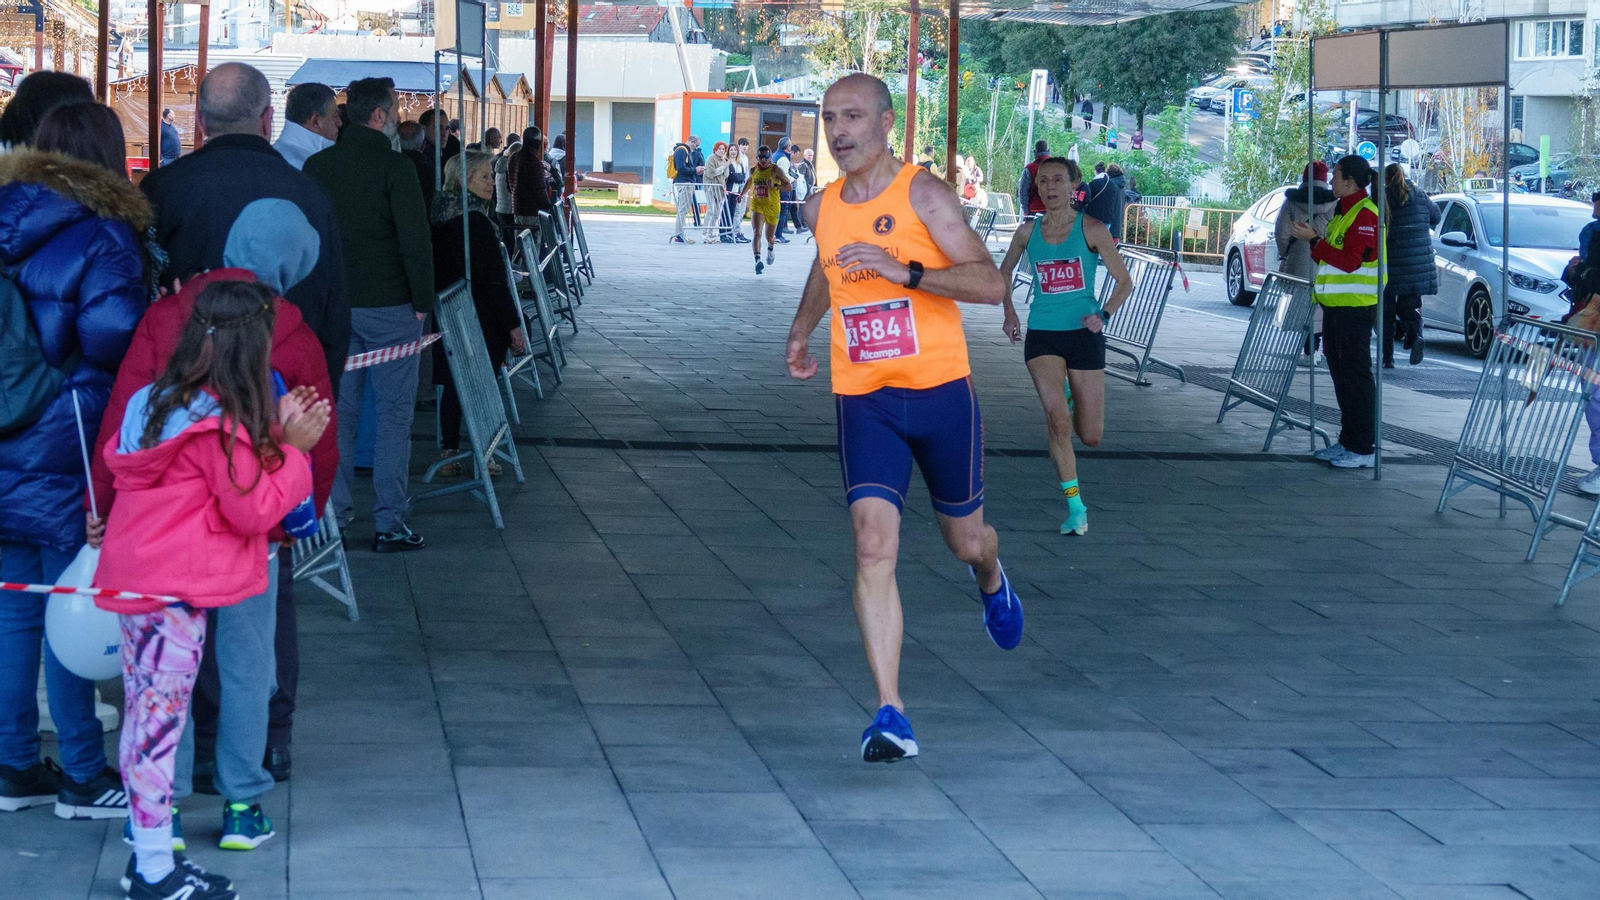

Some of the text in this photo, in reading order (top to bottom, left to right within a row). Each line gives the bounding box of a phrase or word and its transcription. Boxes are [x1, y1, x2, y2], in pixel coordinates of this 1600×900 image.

[1471, 179, 1488, 189] TAXI
[1049, 266, 1075, 281] 740
[859, 316, 901, 342] 584
[859, 347, 901, 361] Alcampo
